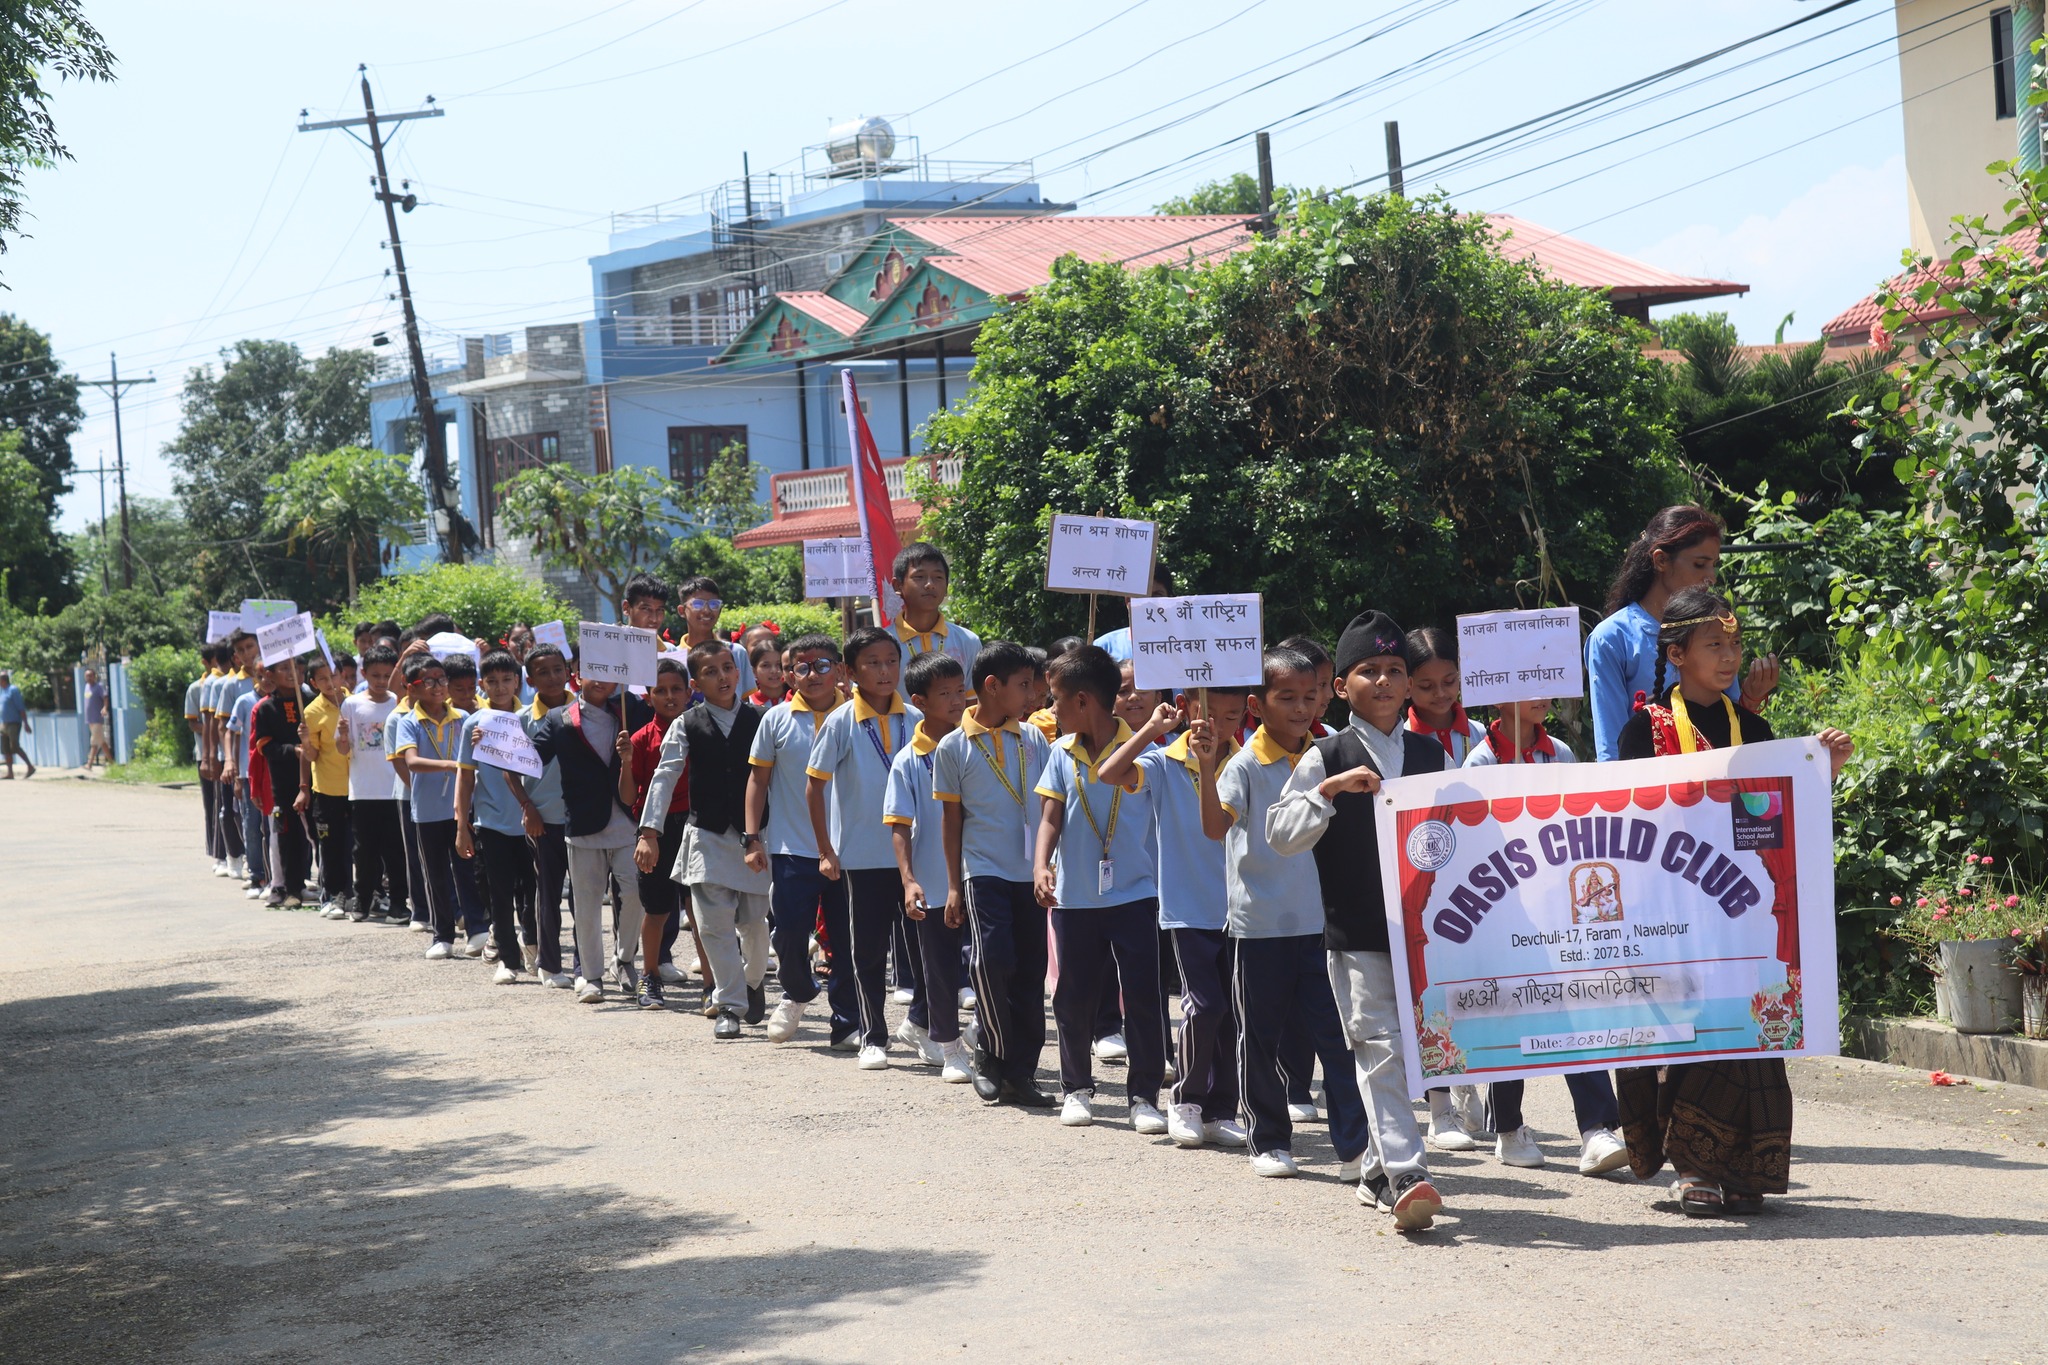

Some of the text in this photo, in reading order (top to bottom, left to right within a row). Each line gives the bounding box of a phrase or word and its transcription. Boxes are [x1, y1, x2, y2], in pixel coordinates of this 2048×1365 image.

[1060, 524, 1149, 540] बाल श्रम शोषण
[840, 542, 861, 553] शिक्षा
[1106, 566, 1127, 581] गरौं
[1146, 600, 1247, 623] ५९ औं राष्ट्रिय
[1462, 615, 1570, 636] आजका बालबालिका
[582, 628, 651, 644] बाल श्रम शोषण
[1138, 636, 1257, 655] बालदिवश सफल
[613, 663, 629, 676] गरौं
[1185, 662, 1214, 682] पारौं
[1465, 664, 1565, 688] भोलिका कर्णधार
[1433, 816, 1762, 945] OASIS CHILD CLUB
[1512, 929, 1582, 947] Devchuli-17,
[1586, 928, 1622, 941] Faram
[1634, 923, 1689, 938] Nawalpur
[1560, 944, 1643, 962] Estd.: 2072 B.S.
[1568, 970, 1661, 1000] बालदिवस
[1530, 1027, 1656, 1050] Date: 2080/05/29
